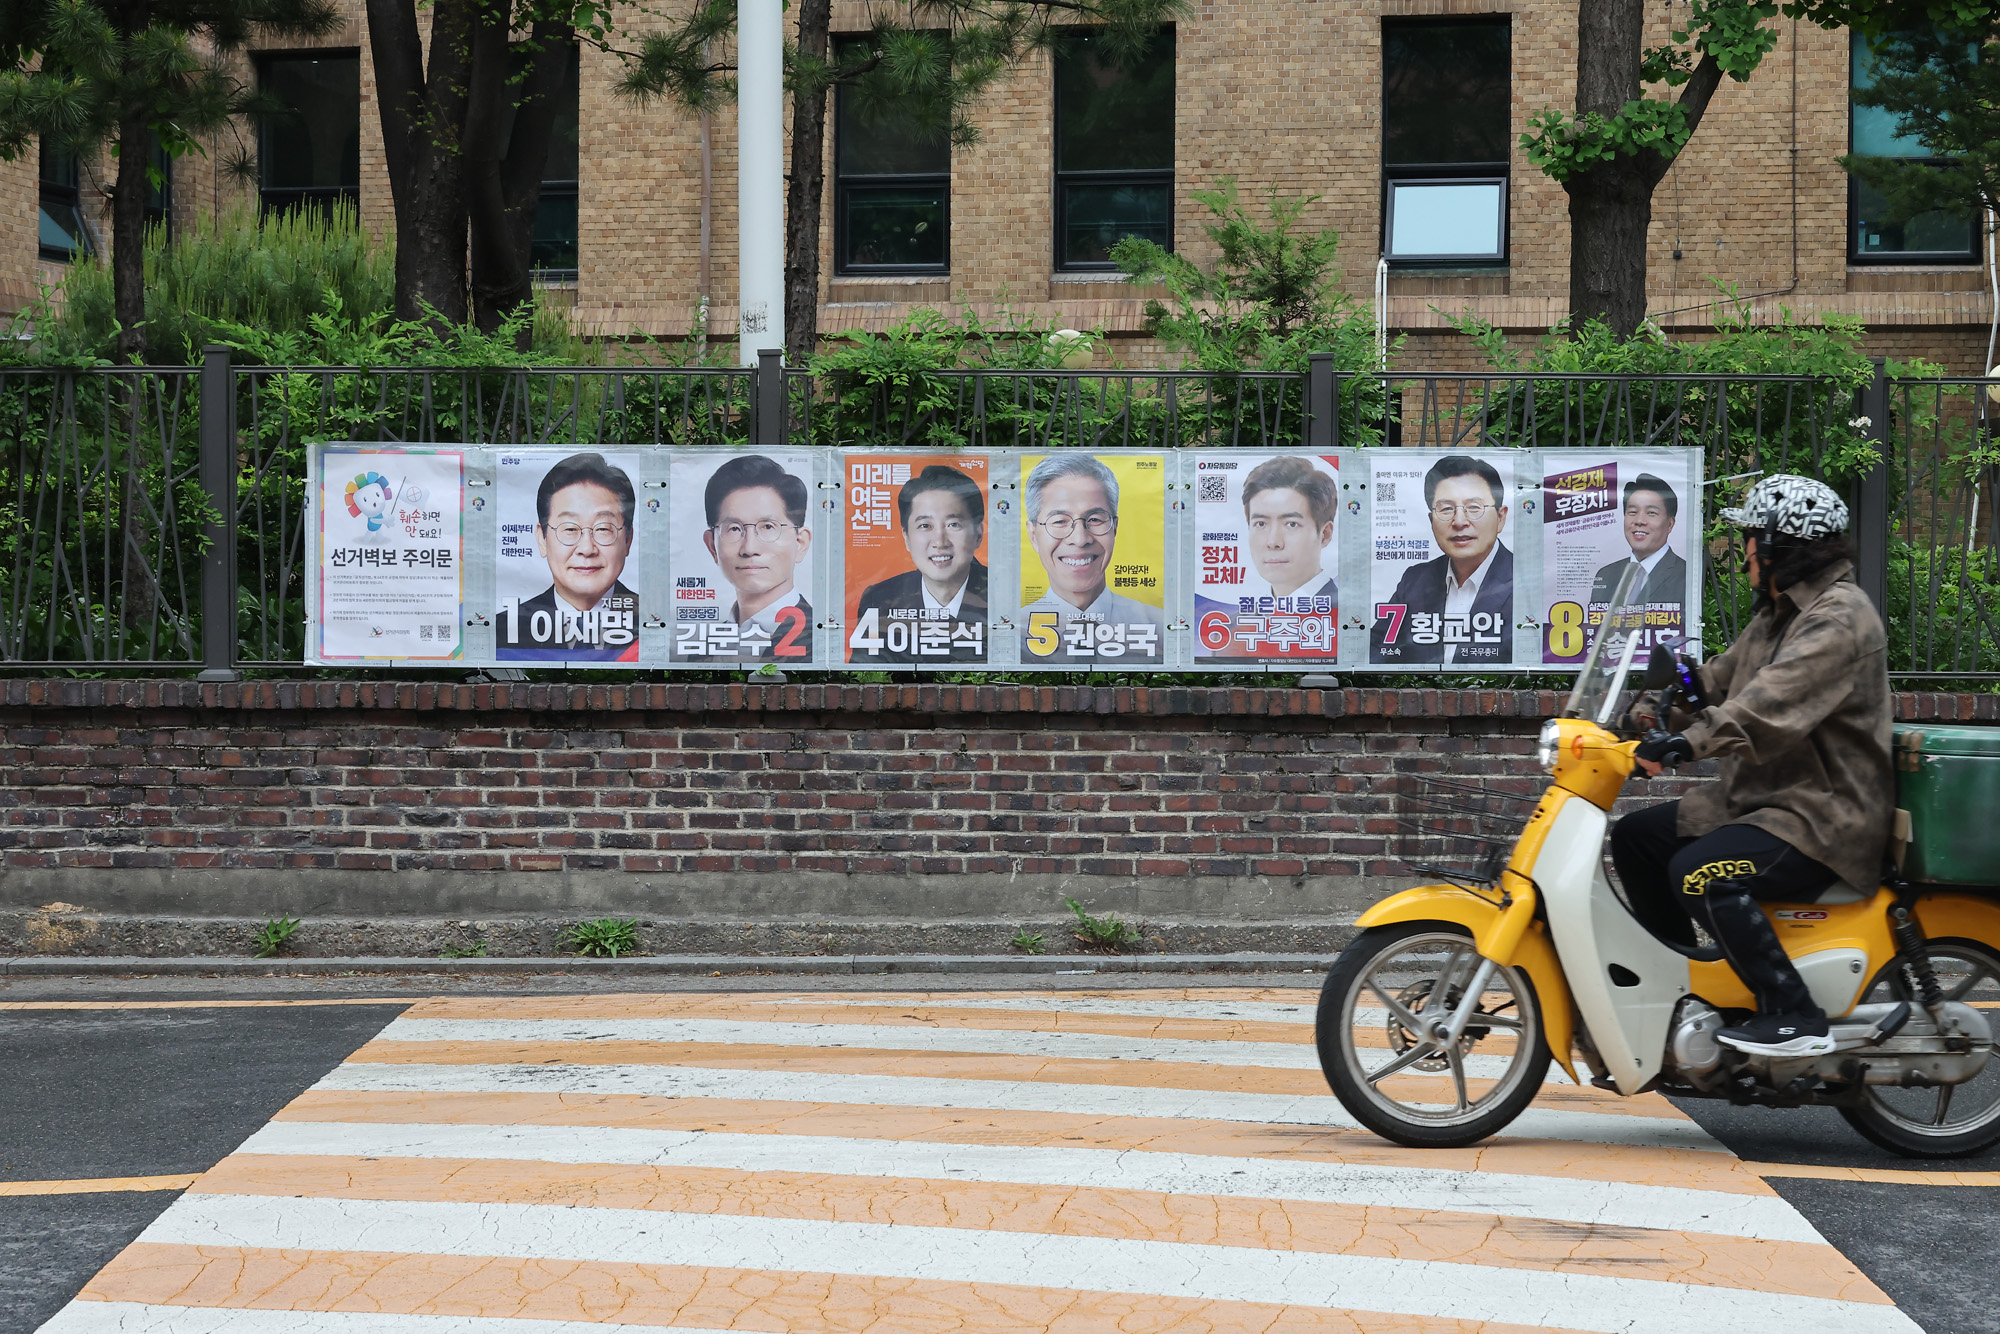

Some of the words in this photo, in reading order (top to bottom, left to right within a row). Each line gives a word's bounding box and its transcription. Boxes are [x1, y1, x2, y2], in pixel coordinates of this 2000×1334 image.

[1206, 462, 1238, 470] 자유통일당
[851, 464, 912, 485] 미래를
[1555, 469, 1607, 495] 선경제,
[851, 486, 891, 508] 여는
[1556, 489, 1608, 516] 후정치!
[400, 509, 440, 524] 훼손하면
[850, 508, 892, 530] 선택
[405, 526, 417, 538] 안
[419, 528, 442, 538] 돼요!
[502, 524, 533, 534] 이제부터
[502, 536, 518, 546] 진짜
[1202, 532, 1238, 541] 광화문정신
[1376, 540, 1406, 550] 부정선거
[1407, 540, 1429, 549] 척결로
[331, 548, 398, 568] 선거벽보
[402, 548, 452, 568] 주의문
[502, 548, 533, 558] 대한민국
[1202, 546, 1238, 564] 정치
[1376, 551, 1405, 560] 청년에게
[1407, 551, 1429, 560] 미래를
[1114, 564, 1149, 575] 갈아엎자!
[1202, 566, 1246, 584] 교체!
[676, 577, 706, 588] 새롭게
[1114, 577, 1139, 588] 불평등
[1140, 577, 1156, 588] 세상
[676, 589, 716, 600] 대한민국
[602, 598, 634, 608] 지금은
[1644, 602, 1680, 611] 경제대통령
[679, 608, 717, 618] 정정당당
[887, 608, 918, 620] 새로운
[919, 608, 950, 620] 대통령
[1644, 612, 1681, 625] 해결사
[502, 597, 521, 644] 1
[530, 610, 634, 644] 이재명
[1376, 602, 1407, 644] 7
[1410, 612, 1504, 644] 황교안
[676, 623, 772, 656] 김문수
[774, 606, 807, 656] 2
[849, 608, 884, 656] 4
[887, 622, 983, 656] 이준석
[1026, 612, 1060, 656] 5
[1063, 622, 1158, 657] 권영국
[1199, 610, 1231, 652] 6
[1234, 615, 1336, 652] 구주와
[1549, 600, 1584, 657] 8
[1380, 647, 1401, 656] 무소속
[1461, 648, 1469, 656] 전
[1470, 648, 1498, 656] 국무총리
[1683, 860, 1757, 895] Kappa
